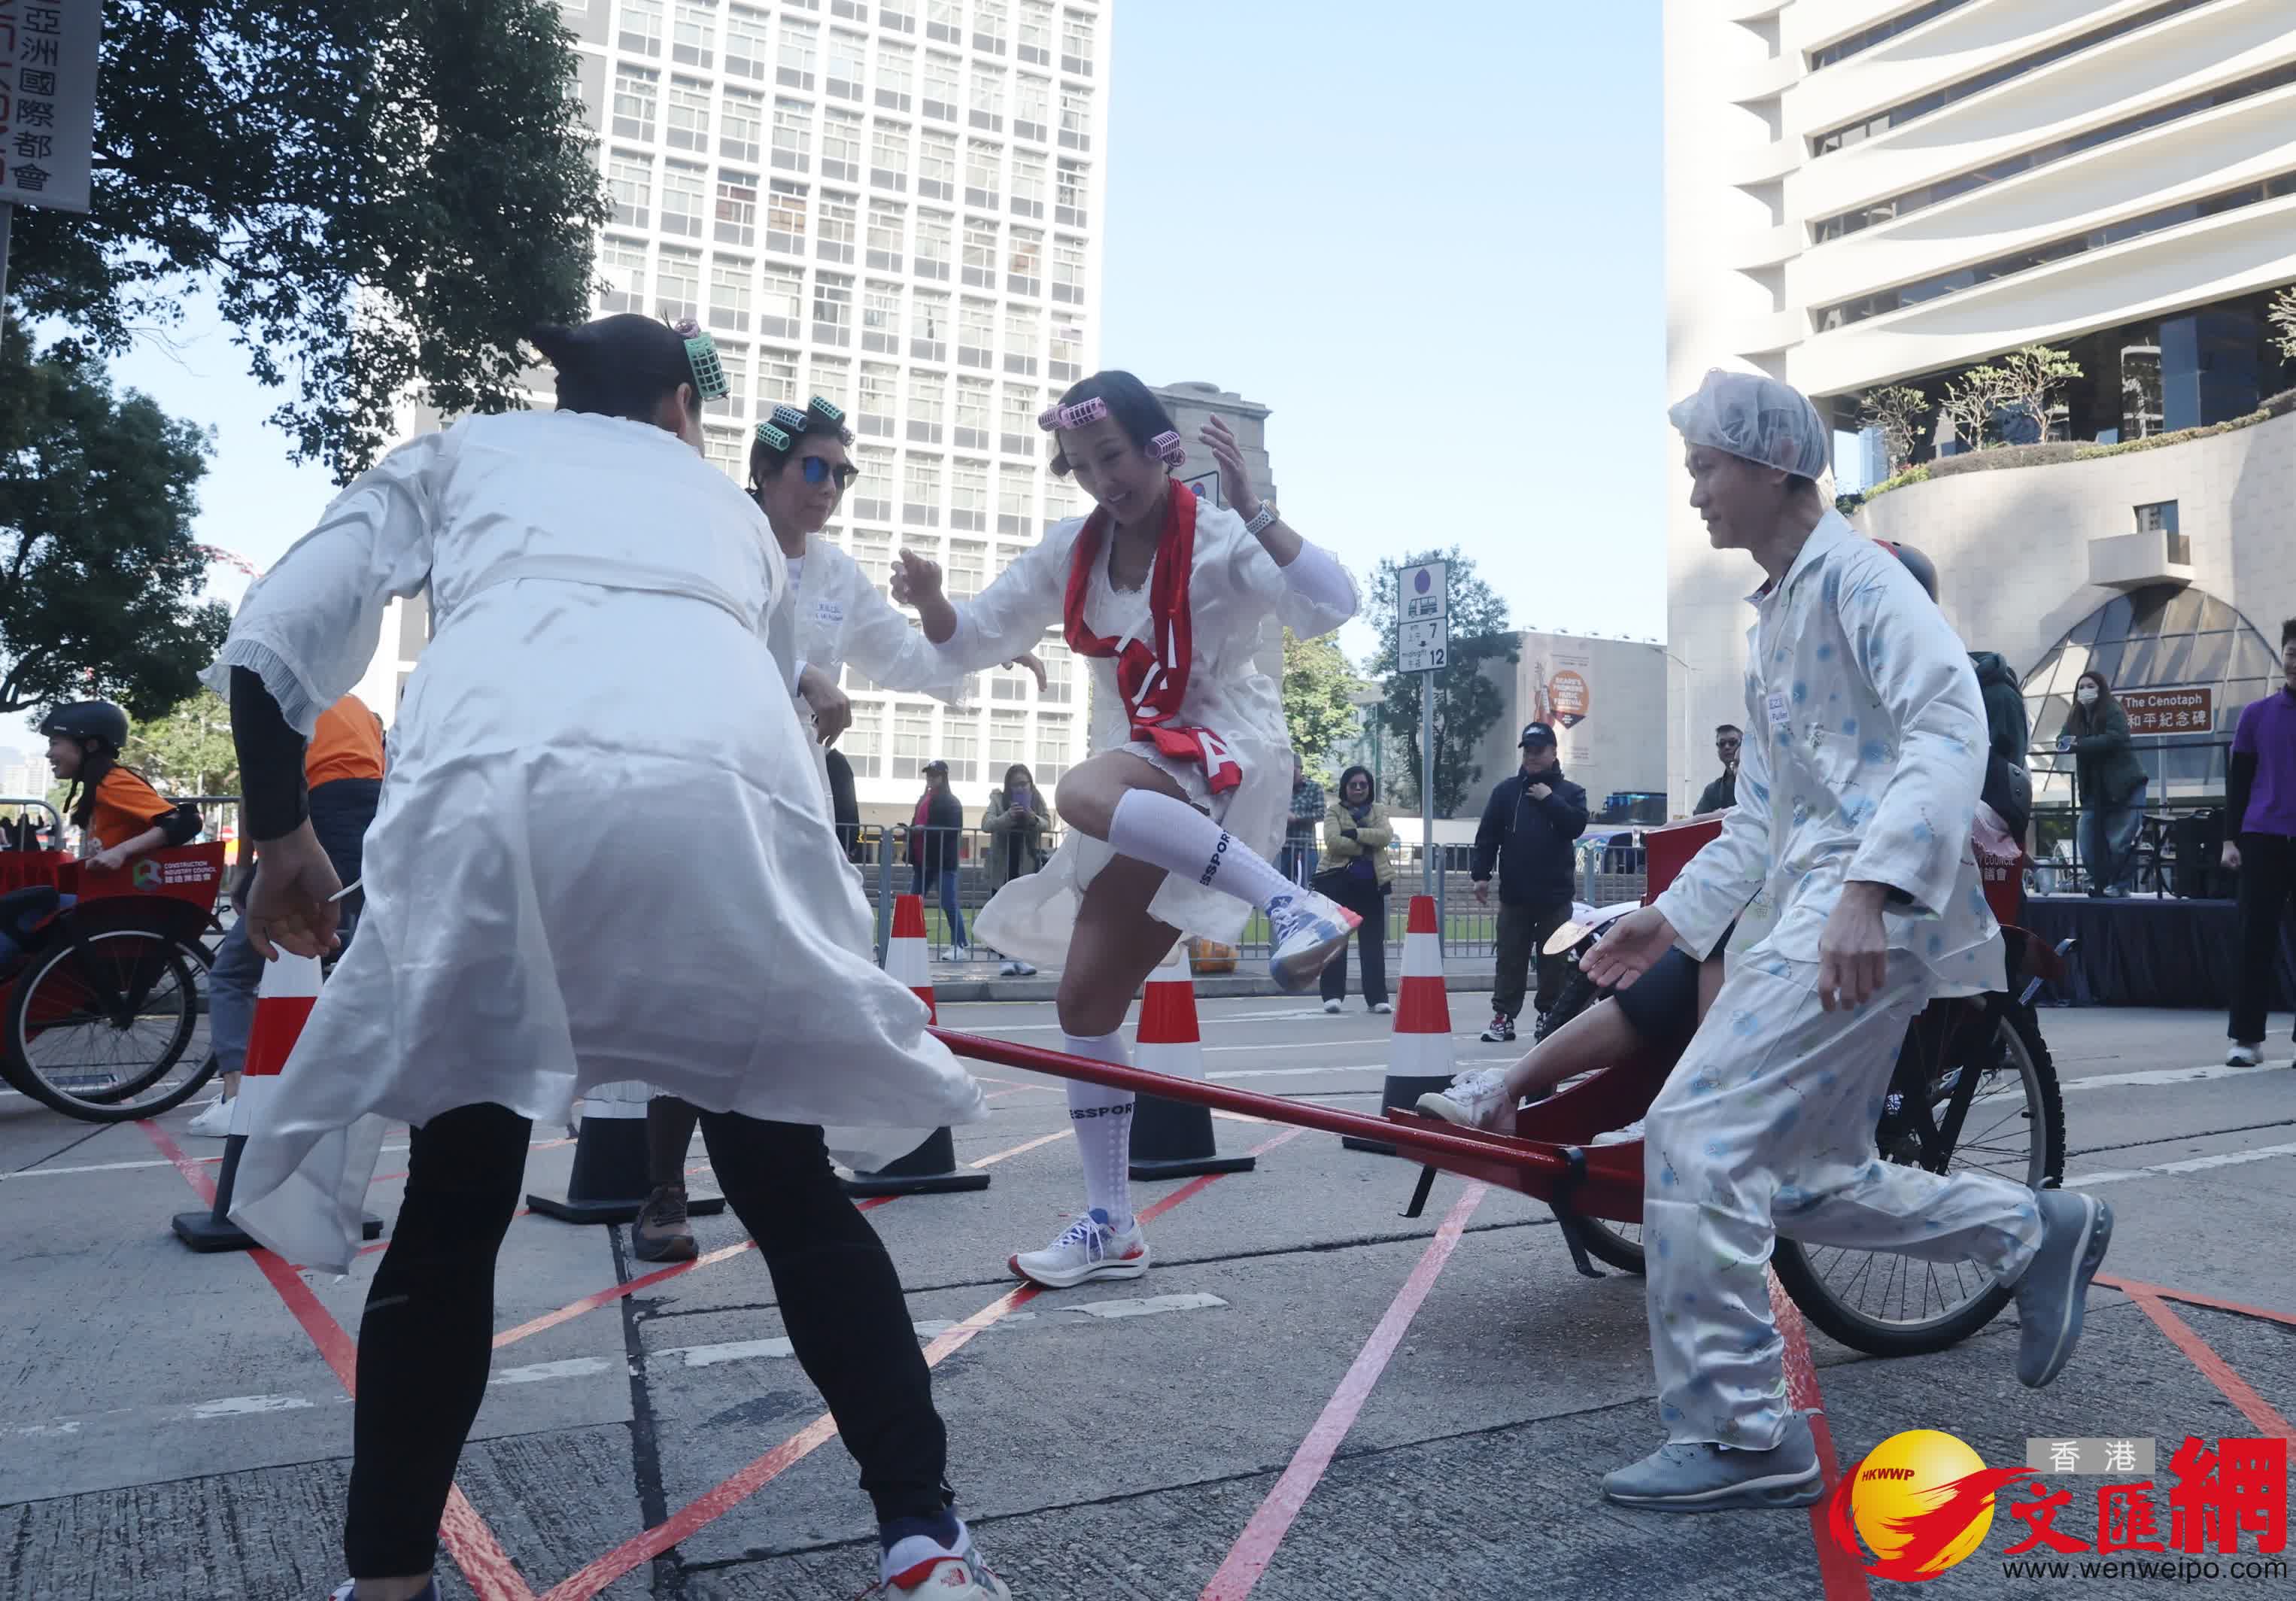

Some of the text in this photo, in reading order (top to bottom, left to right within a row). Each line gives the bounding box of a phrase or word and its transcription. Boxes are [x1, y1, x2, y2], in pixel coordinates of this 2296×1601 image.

[10, 6, 60, 191] 亞洲國際都會
[1429, 623, 1438, 638] 7
[1430, 649, 1444, 666] 12
[2125, 693, 2203, 708] The Cenotaph
[2127, 709, 2206, 728] 和平紀念碑
